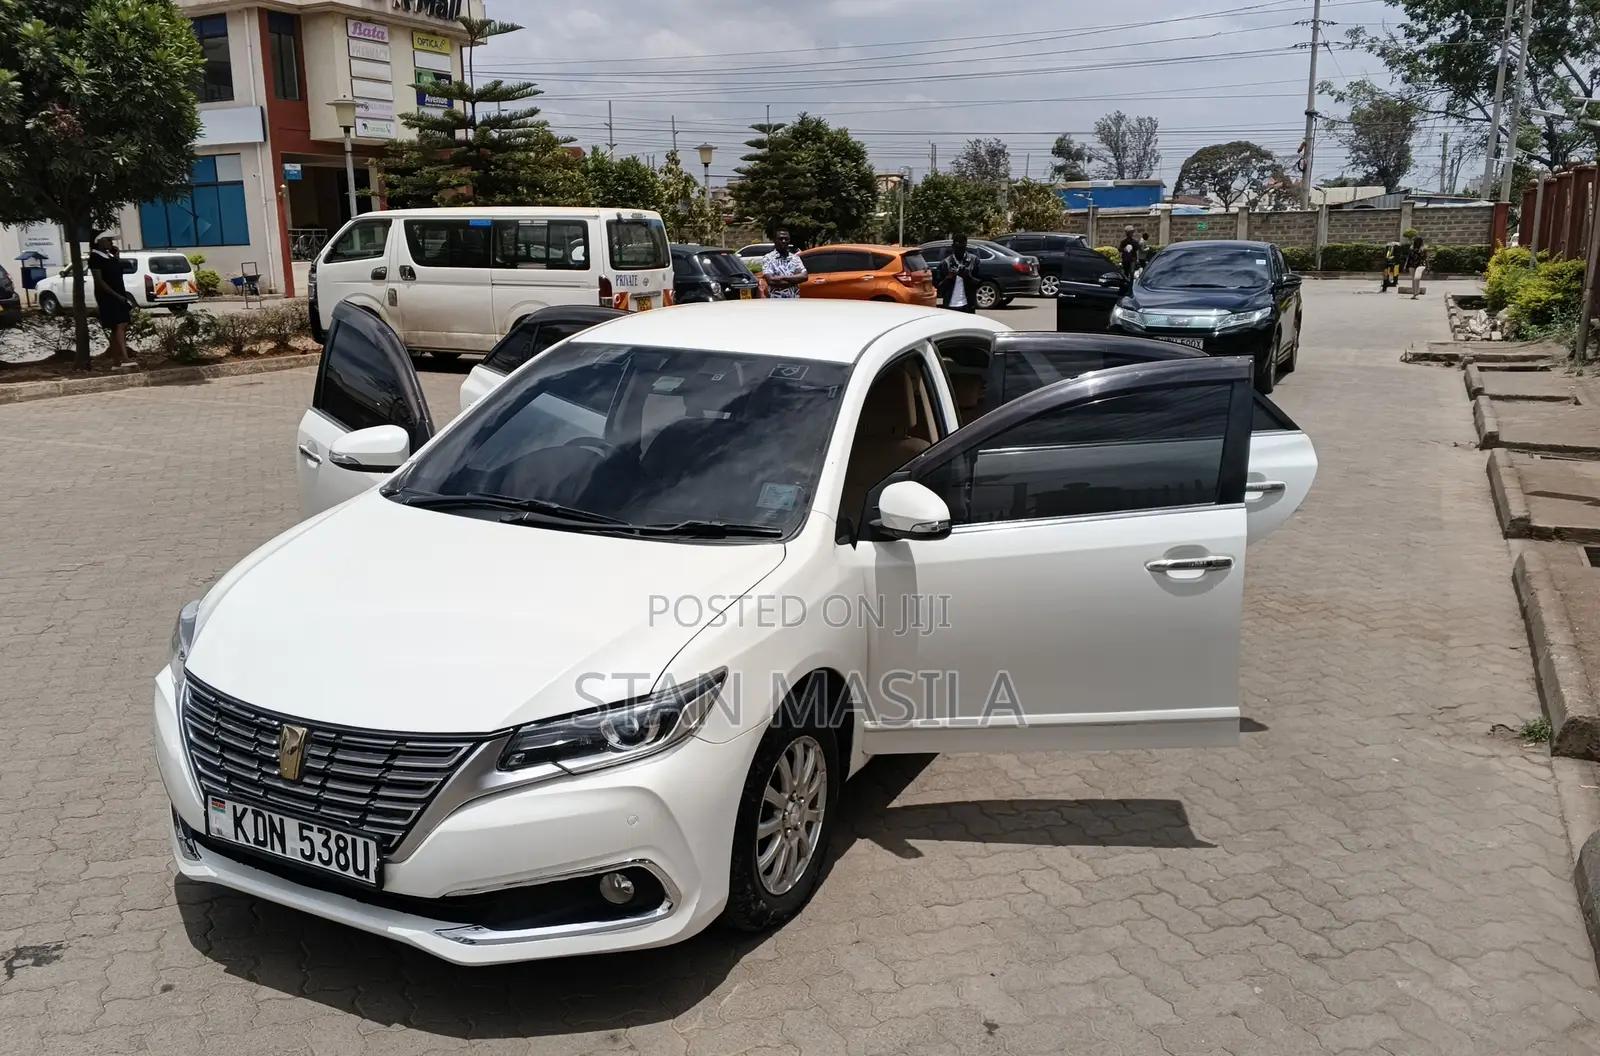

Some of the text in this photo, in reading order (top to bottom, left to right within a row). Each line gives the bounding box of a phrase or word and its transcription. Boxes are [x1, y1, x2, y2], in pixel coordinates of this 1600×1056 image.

[351, 21, 385, 40] Bata
[425, 94, 448, 105] Avenue
[616, 275, 638, 287] PRIVATE
[233, 804, 370, 880] KDN 538U
